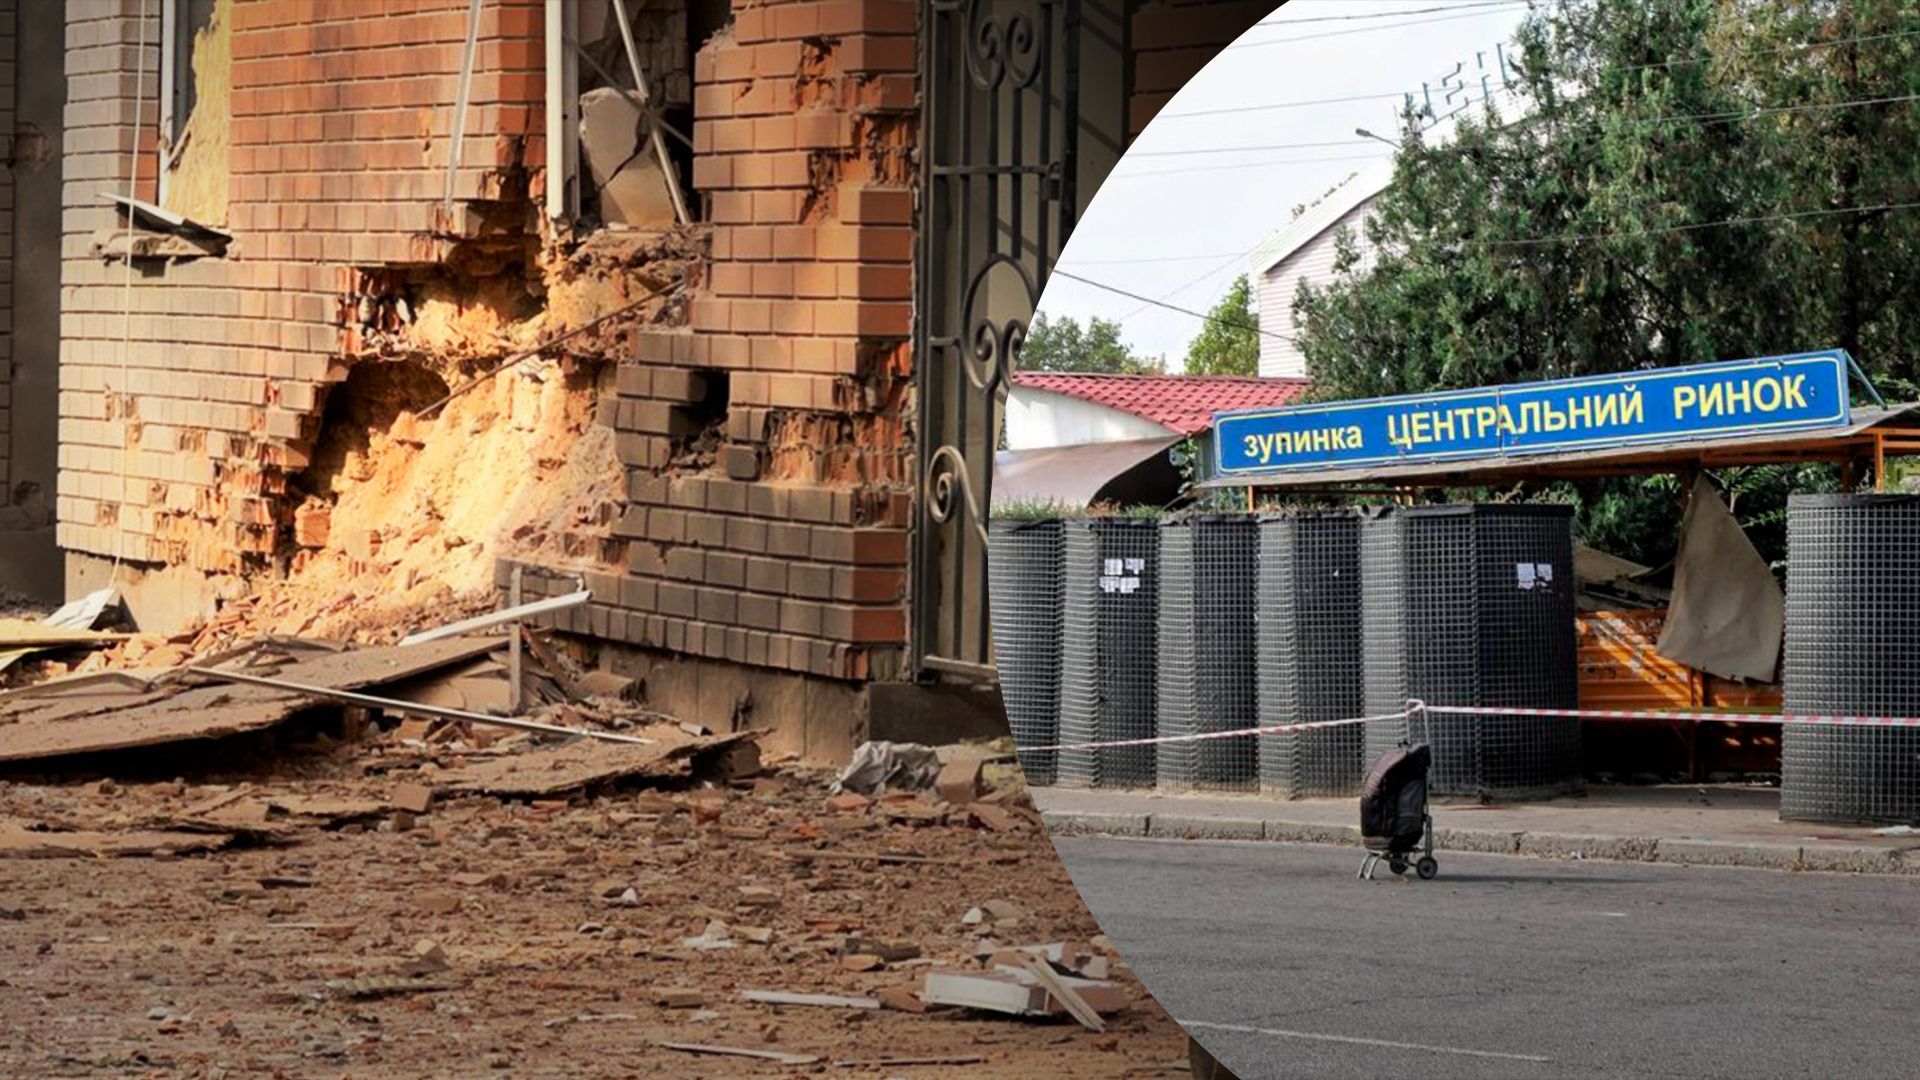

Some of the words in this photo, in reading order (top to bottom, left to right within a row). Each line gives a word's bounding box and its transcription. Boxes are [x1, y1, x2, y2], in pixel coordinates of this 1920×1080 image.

[1243, 425, 1364, 464] зупинка
[1387, 384, 1644, 450] ЦЕНТРАЛЬНИЙ
[1673, 374, 1808, 420] РИНОК
